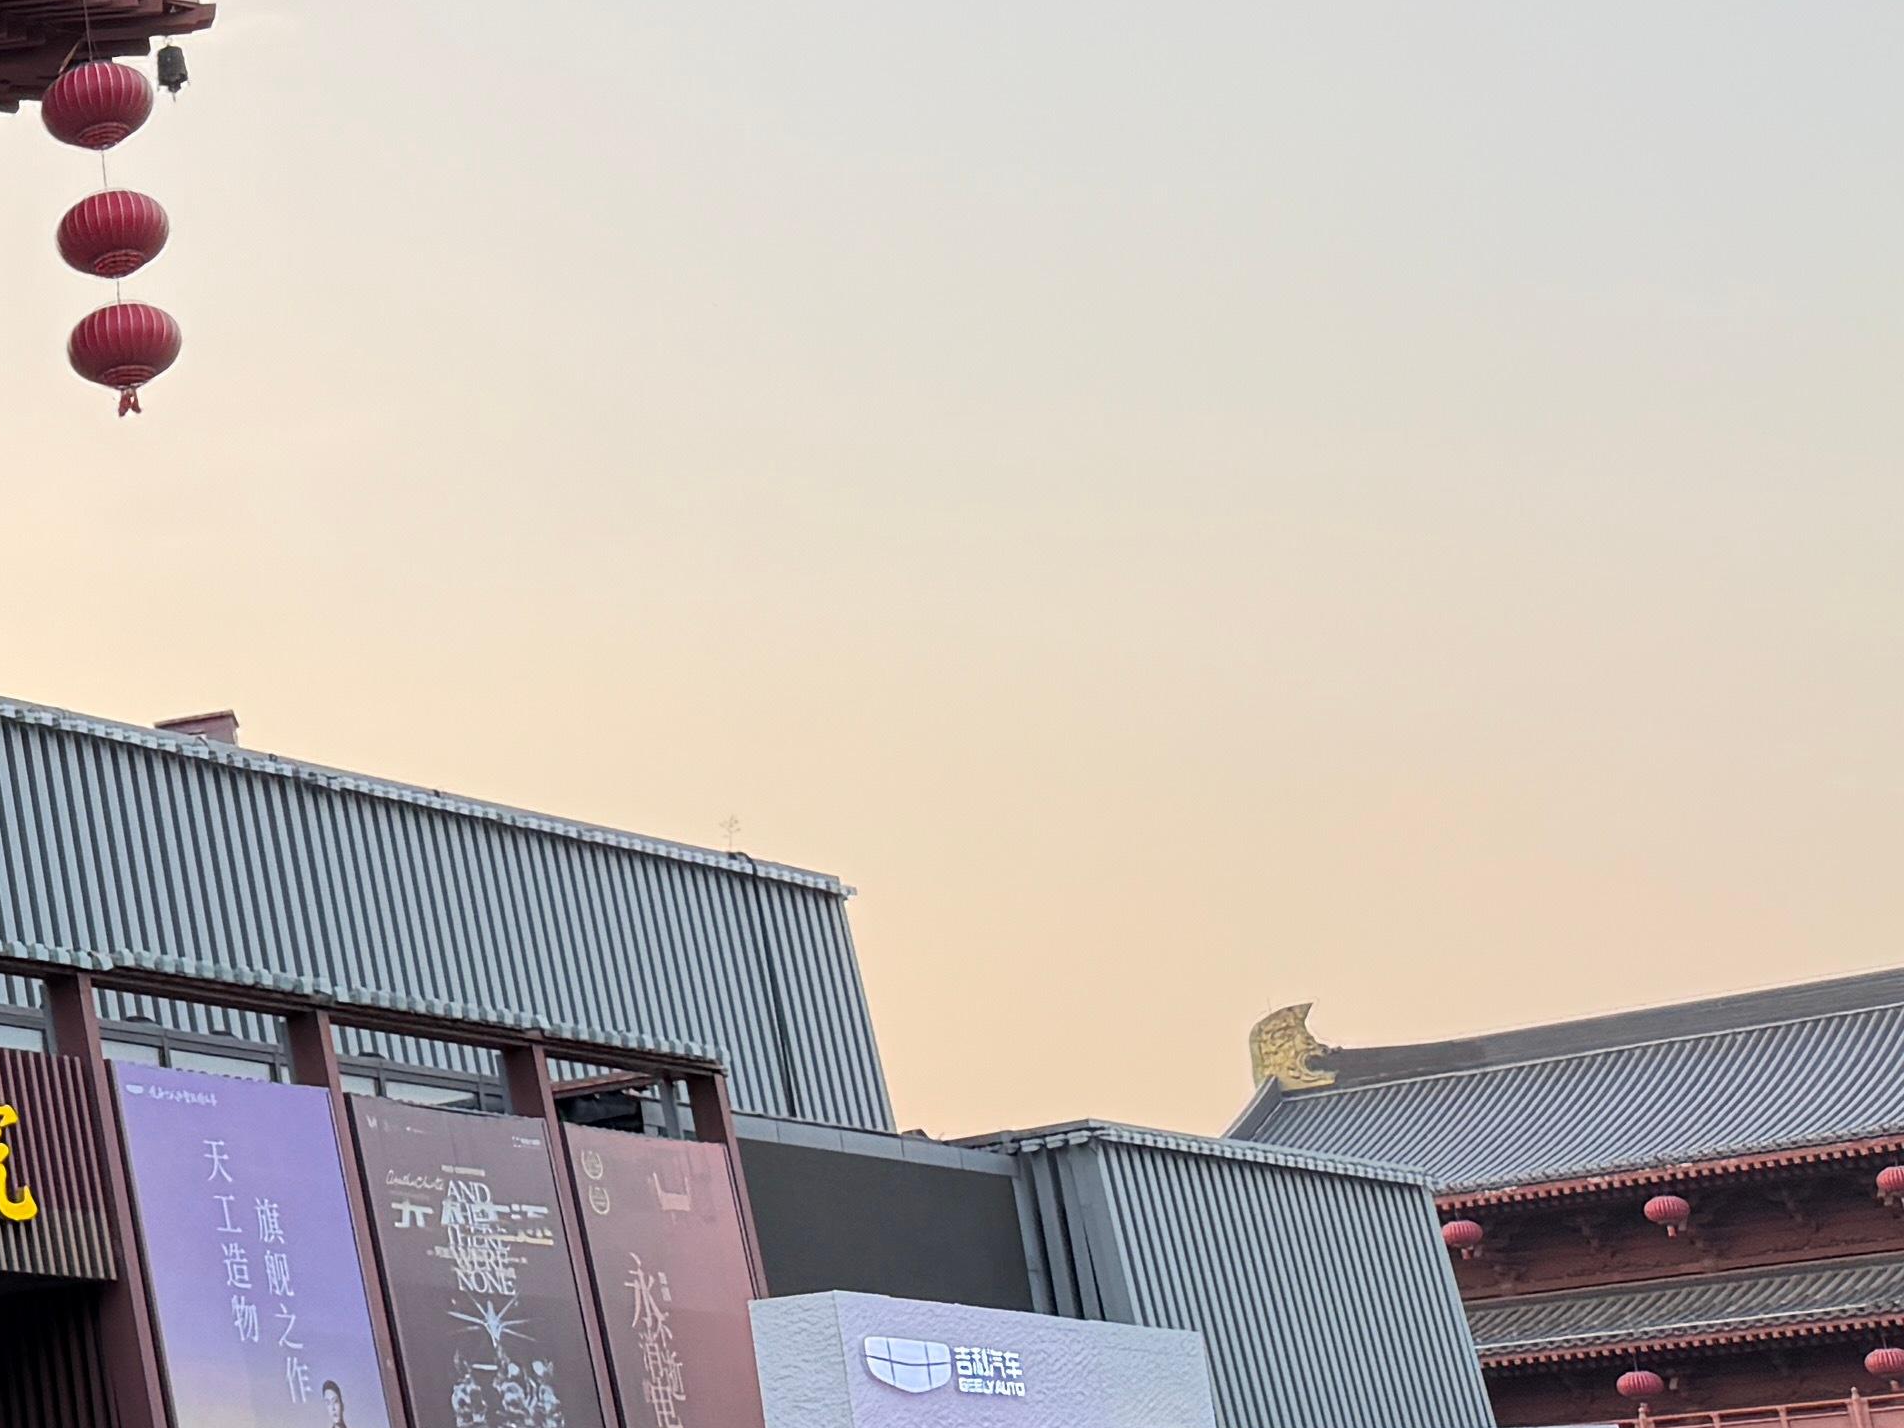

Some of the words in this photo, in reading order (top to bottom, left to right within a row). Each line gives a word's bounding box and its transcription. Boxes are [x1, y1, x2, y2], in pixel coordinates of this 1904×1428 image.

[446, 1179, 492, 1204] AND
[202, 1138, 260, 1344] 天工造物
[453, 1266, 517, 1296] NONE
[252, 1195, 314, 1404] 旗舰之作
[953, 1346, 1024, 1379] 吉利汽车
